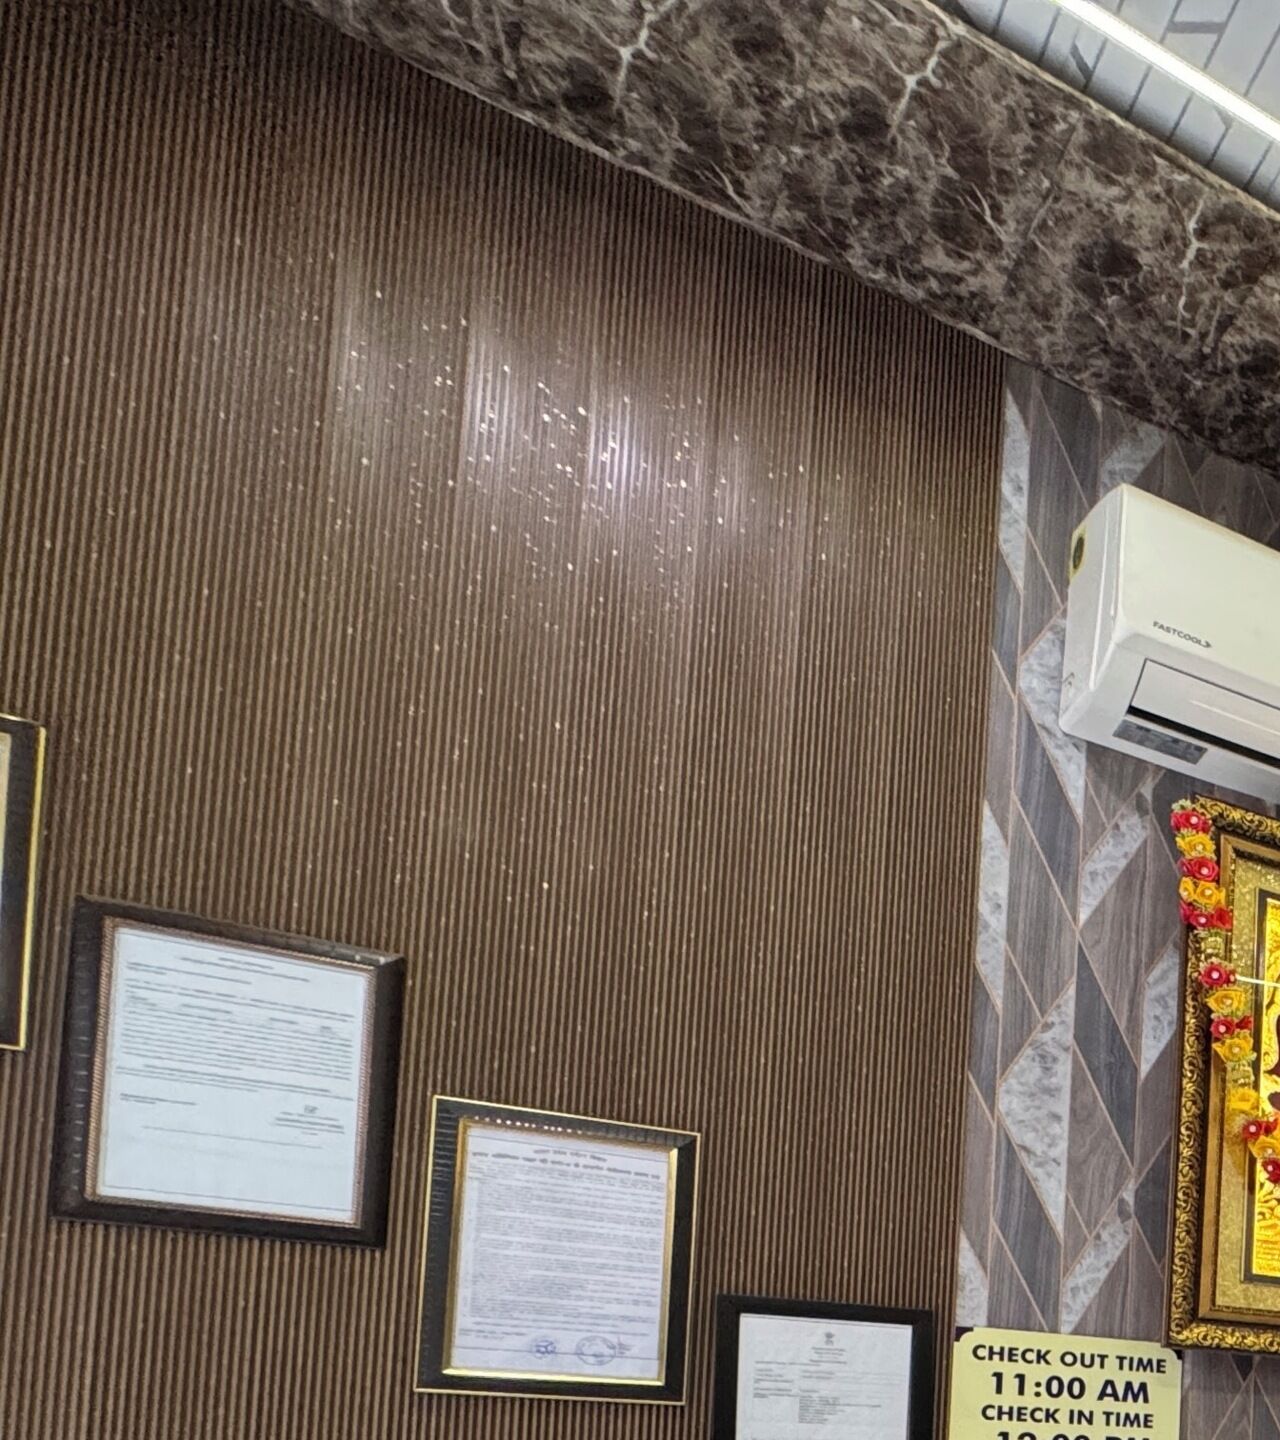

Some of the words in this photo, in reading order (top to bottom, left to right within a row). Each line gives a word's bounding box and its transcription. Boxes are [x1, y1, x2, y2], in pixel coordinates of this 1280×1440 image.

[1153, 621, 1206, 648] FASTCOOL
[972, 1344, 1051, 1365] CHECK
[1060, 1351, 1108, 1369] OUT
[1116, 1355, 1166, 1373] TIME
[991, 1372, 1086, 1400] 11:00
[1097, 1379, 1150, 1404] AM
[981, 1405, 1060, 1424] CHECK
[1069, 1409, 1094, 1426] IN
[1102, 1412, 1154, 1428] TIME
